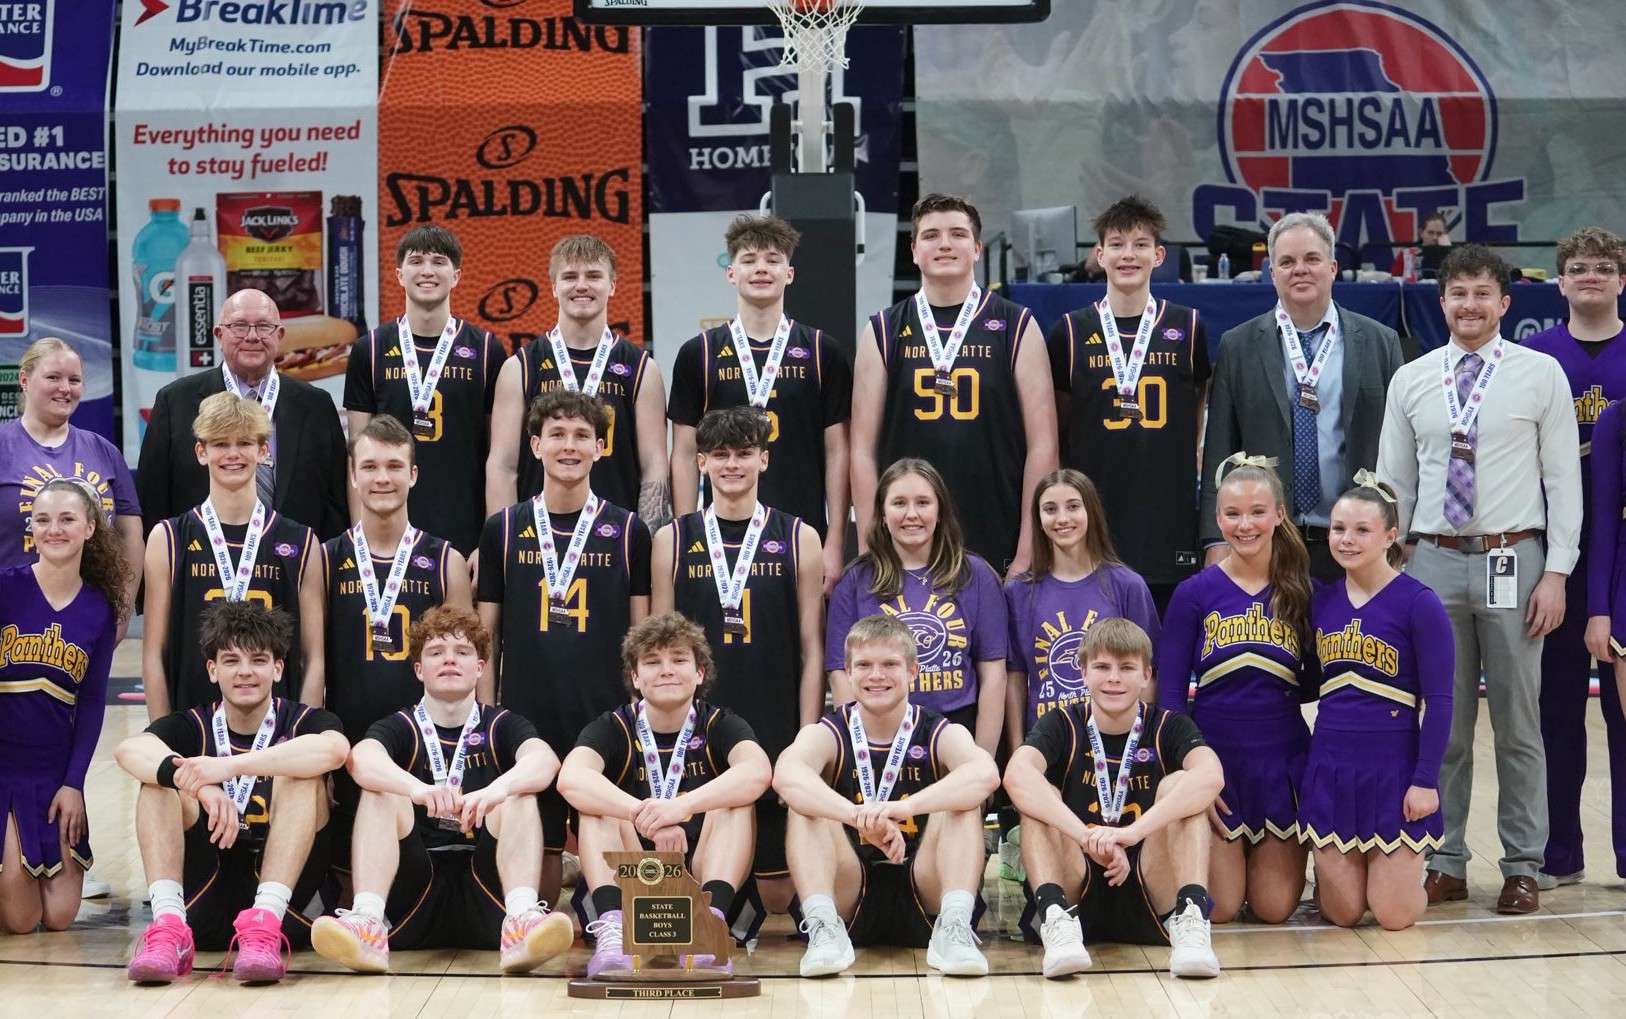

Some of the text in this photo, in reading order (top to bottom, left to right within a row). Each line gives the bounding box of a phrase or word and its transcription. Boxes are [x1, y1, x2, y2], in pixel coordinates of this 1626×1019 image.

[392, 8, 630, 54] SPALDING
[169, 36, 332, 55] MyBreakTime.com
[136, 62, 361, 78] Download our mobile app.
[1269, 97, 1443, 150] MSHSAA
[33, 126, 64, 147] #1
[133, 120, 361, 149] Everything you need
[168, 152, 328, 180] to stay fueled!
[47, 188, 69, 201] the
[70, 187, 105, 201] BEST
[386, 168, 630, 227] SPALDING
[35, 209, 48, 222] in
[51, 209, 73, 222] the
[75, 207, 104, 222] USA
[1192, 176, 1526, 268] STATE
[193, 286, 207, 345] essentia
[905, 345, 992, 359] NOR ATTE
[1089, 353, 1177, 368] NOR ATTE
[385, 366, 473, 380] NOR ATTE
[718, 366, 806, 381] NOR ATTE
[1482, 362, 1496, 379] YEARS
[541, 380, 627, 396] NOR ATTE
[914, 367, 980, 421] 50
[1101, 376, 1167, 430] 30
[518, 551, 612, 566] NOR ATTE
[1495, 556, 1508, 573] C
[191, 563, 281, 580] NOR ATTE
[688, 562, 782, 578] NOR ATTE
[340, 580, 430, 595] NOR ATTE
[538, 578, 589, 632] 14
[923, 594, 969, 649] FOUR
[1201, 602, 1299, 661] Panthers
[362, 604, 411, 661] 10
[0, 623, 90, 683] Panthers
[942, 650, 963, 668] 26
[909, 669, 964, 692] HERS
[676, 728, 692, 759] 100 YEARS
[890, 736, 906, 767] 100 YEARS
[1089, 735, 1102, 755] YEARS
[1124, 739, 1138, 770] 100 YEARS
[664, 778, 677, 800] MSHSAA
[861, 766, 873, 797] 1926-2026
[1098, 777, 1111, 808] 1926-2026
[620, 864, 682, 878] 20 26
[639, 912, 687, 920] BASKETBALL
[633, 988, 696, 998] THIRD PLACE
